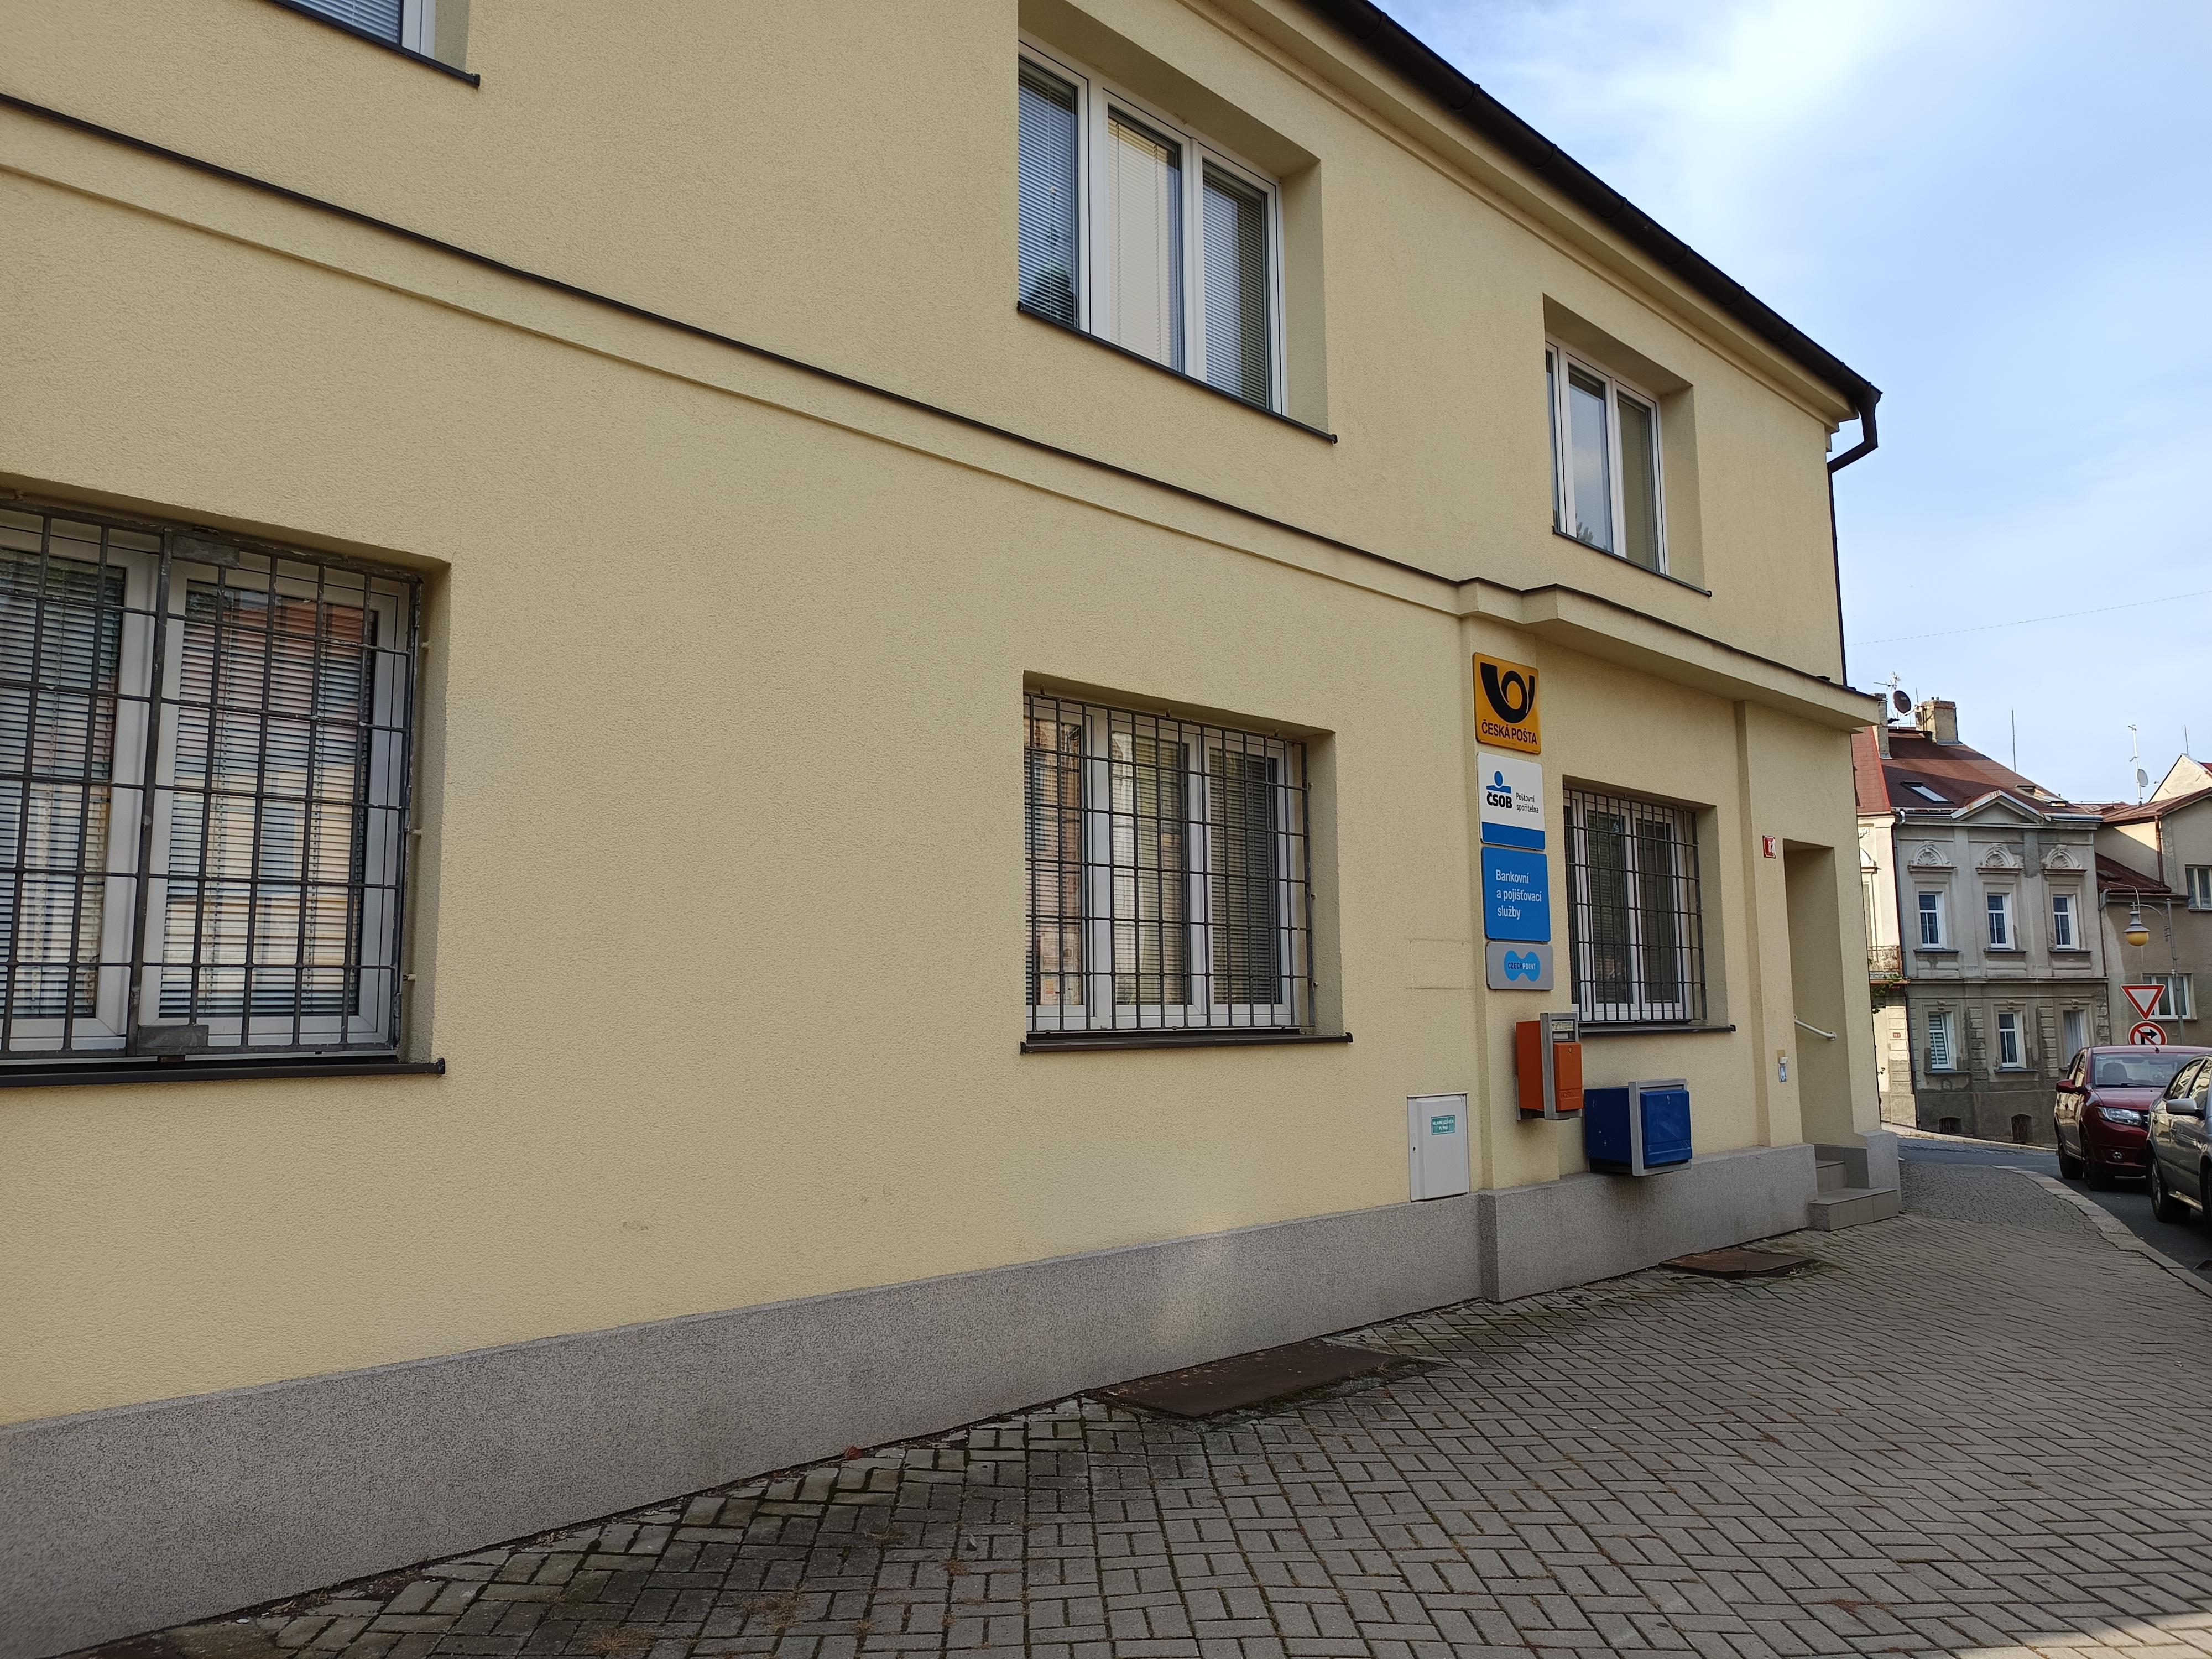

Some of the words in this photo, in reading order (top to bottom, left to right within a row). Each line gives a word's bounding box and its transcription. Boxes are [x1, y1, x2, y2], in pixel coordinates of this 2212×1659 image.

[1481, 719, 1510, 739] ČESKÁ
[1511, 728, 1537, 744] POŠTA
[1486, 791, 1512, 809] ČSOB
[1516, 792, 1535, 803] Poštovní
[1516, 804, 1539, 813] spořitelna
[1495, 869, 1530, 884] Bankovní
[1496, 890, 1501, 899] a
[1503, 888, 1542, 902] pojišťovací
[1497, 905, 1521, 920] služby
